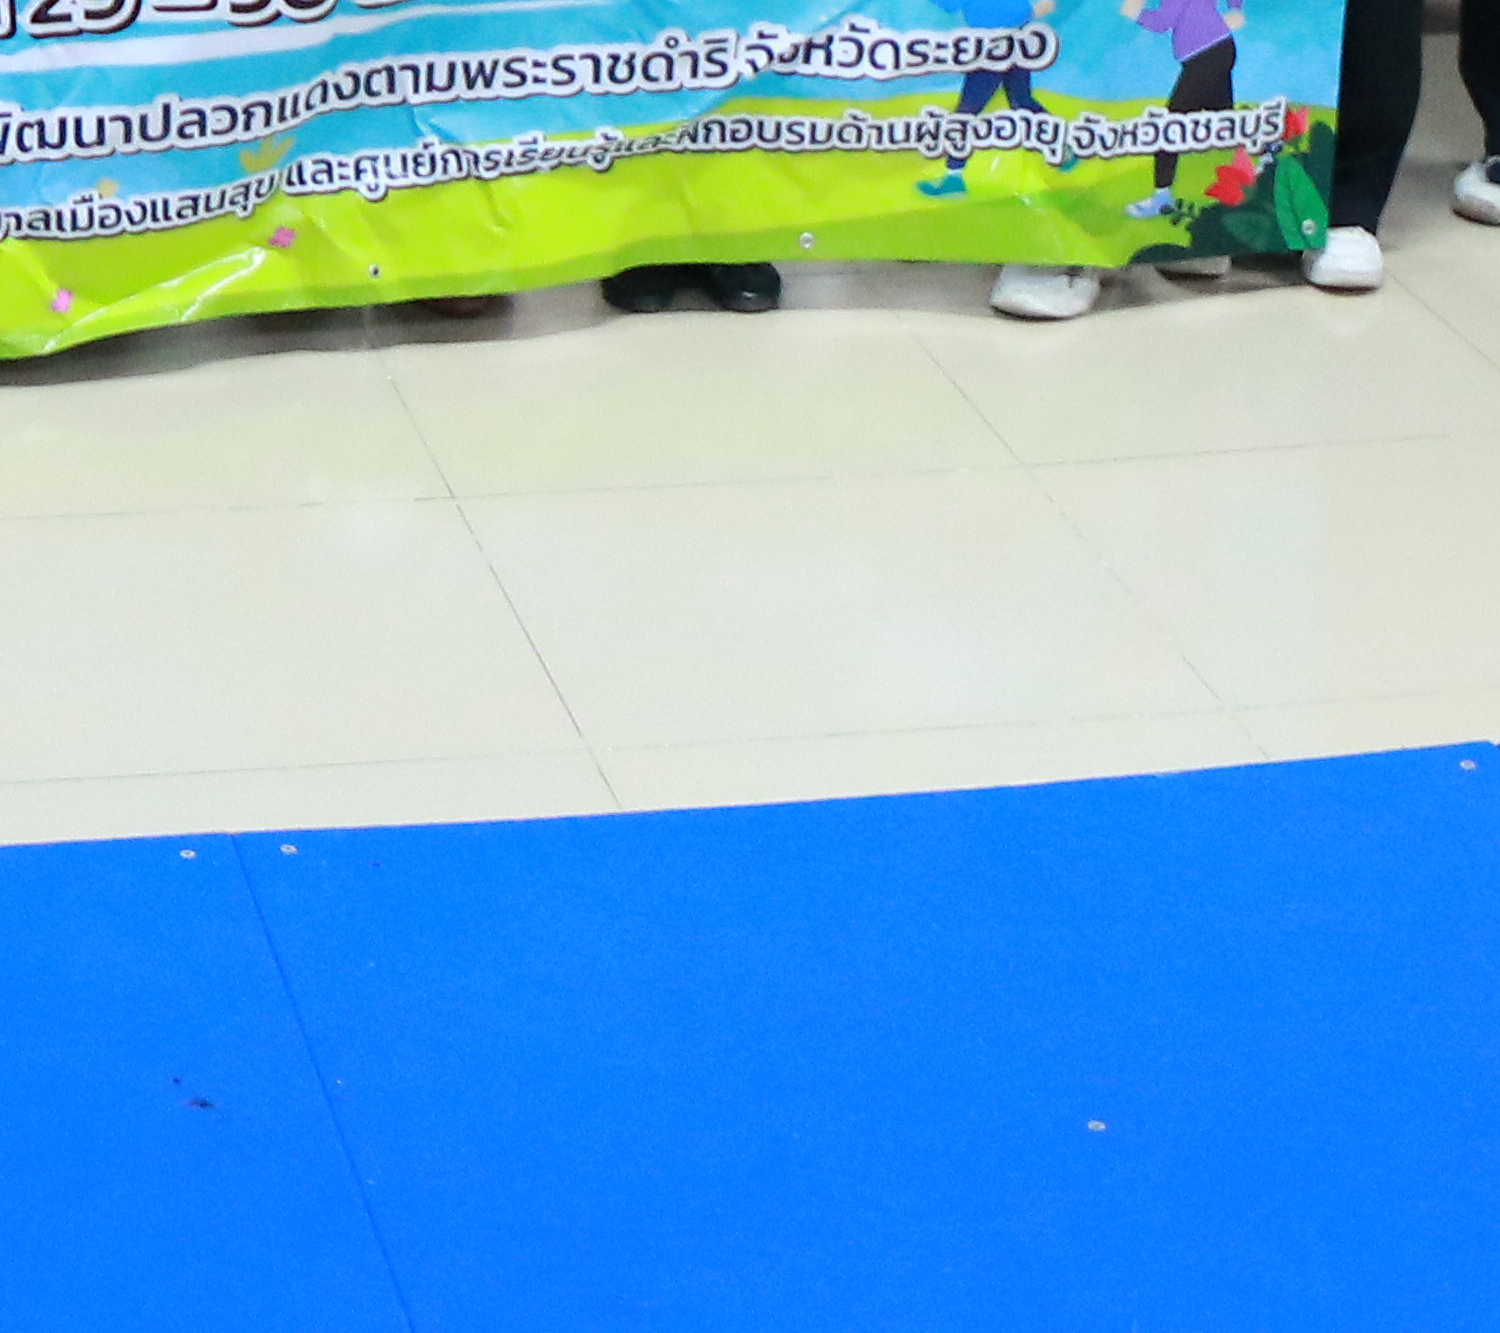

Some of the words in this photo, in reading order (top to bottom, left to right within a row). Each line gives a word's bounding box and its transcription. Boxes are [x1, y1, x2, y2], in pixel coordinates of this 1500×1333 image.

[1072, 101, 1285, 151] จังหวัดชลบุรี
